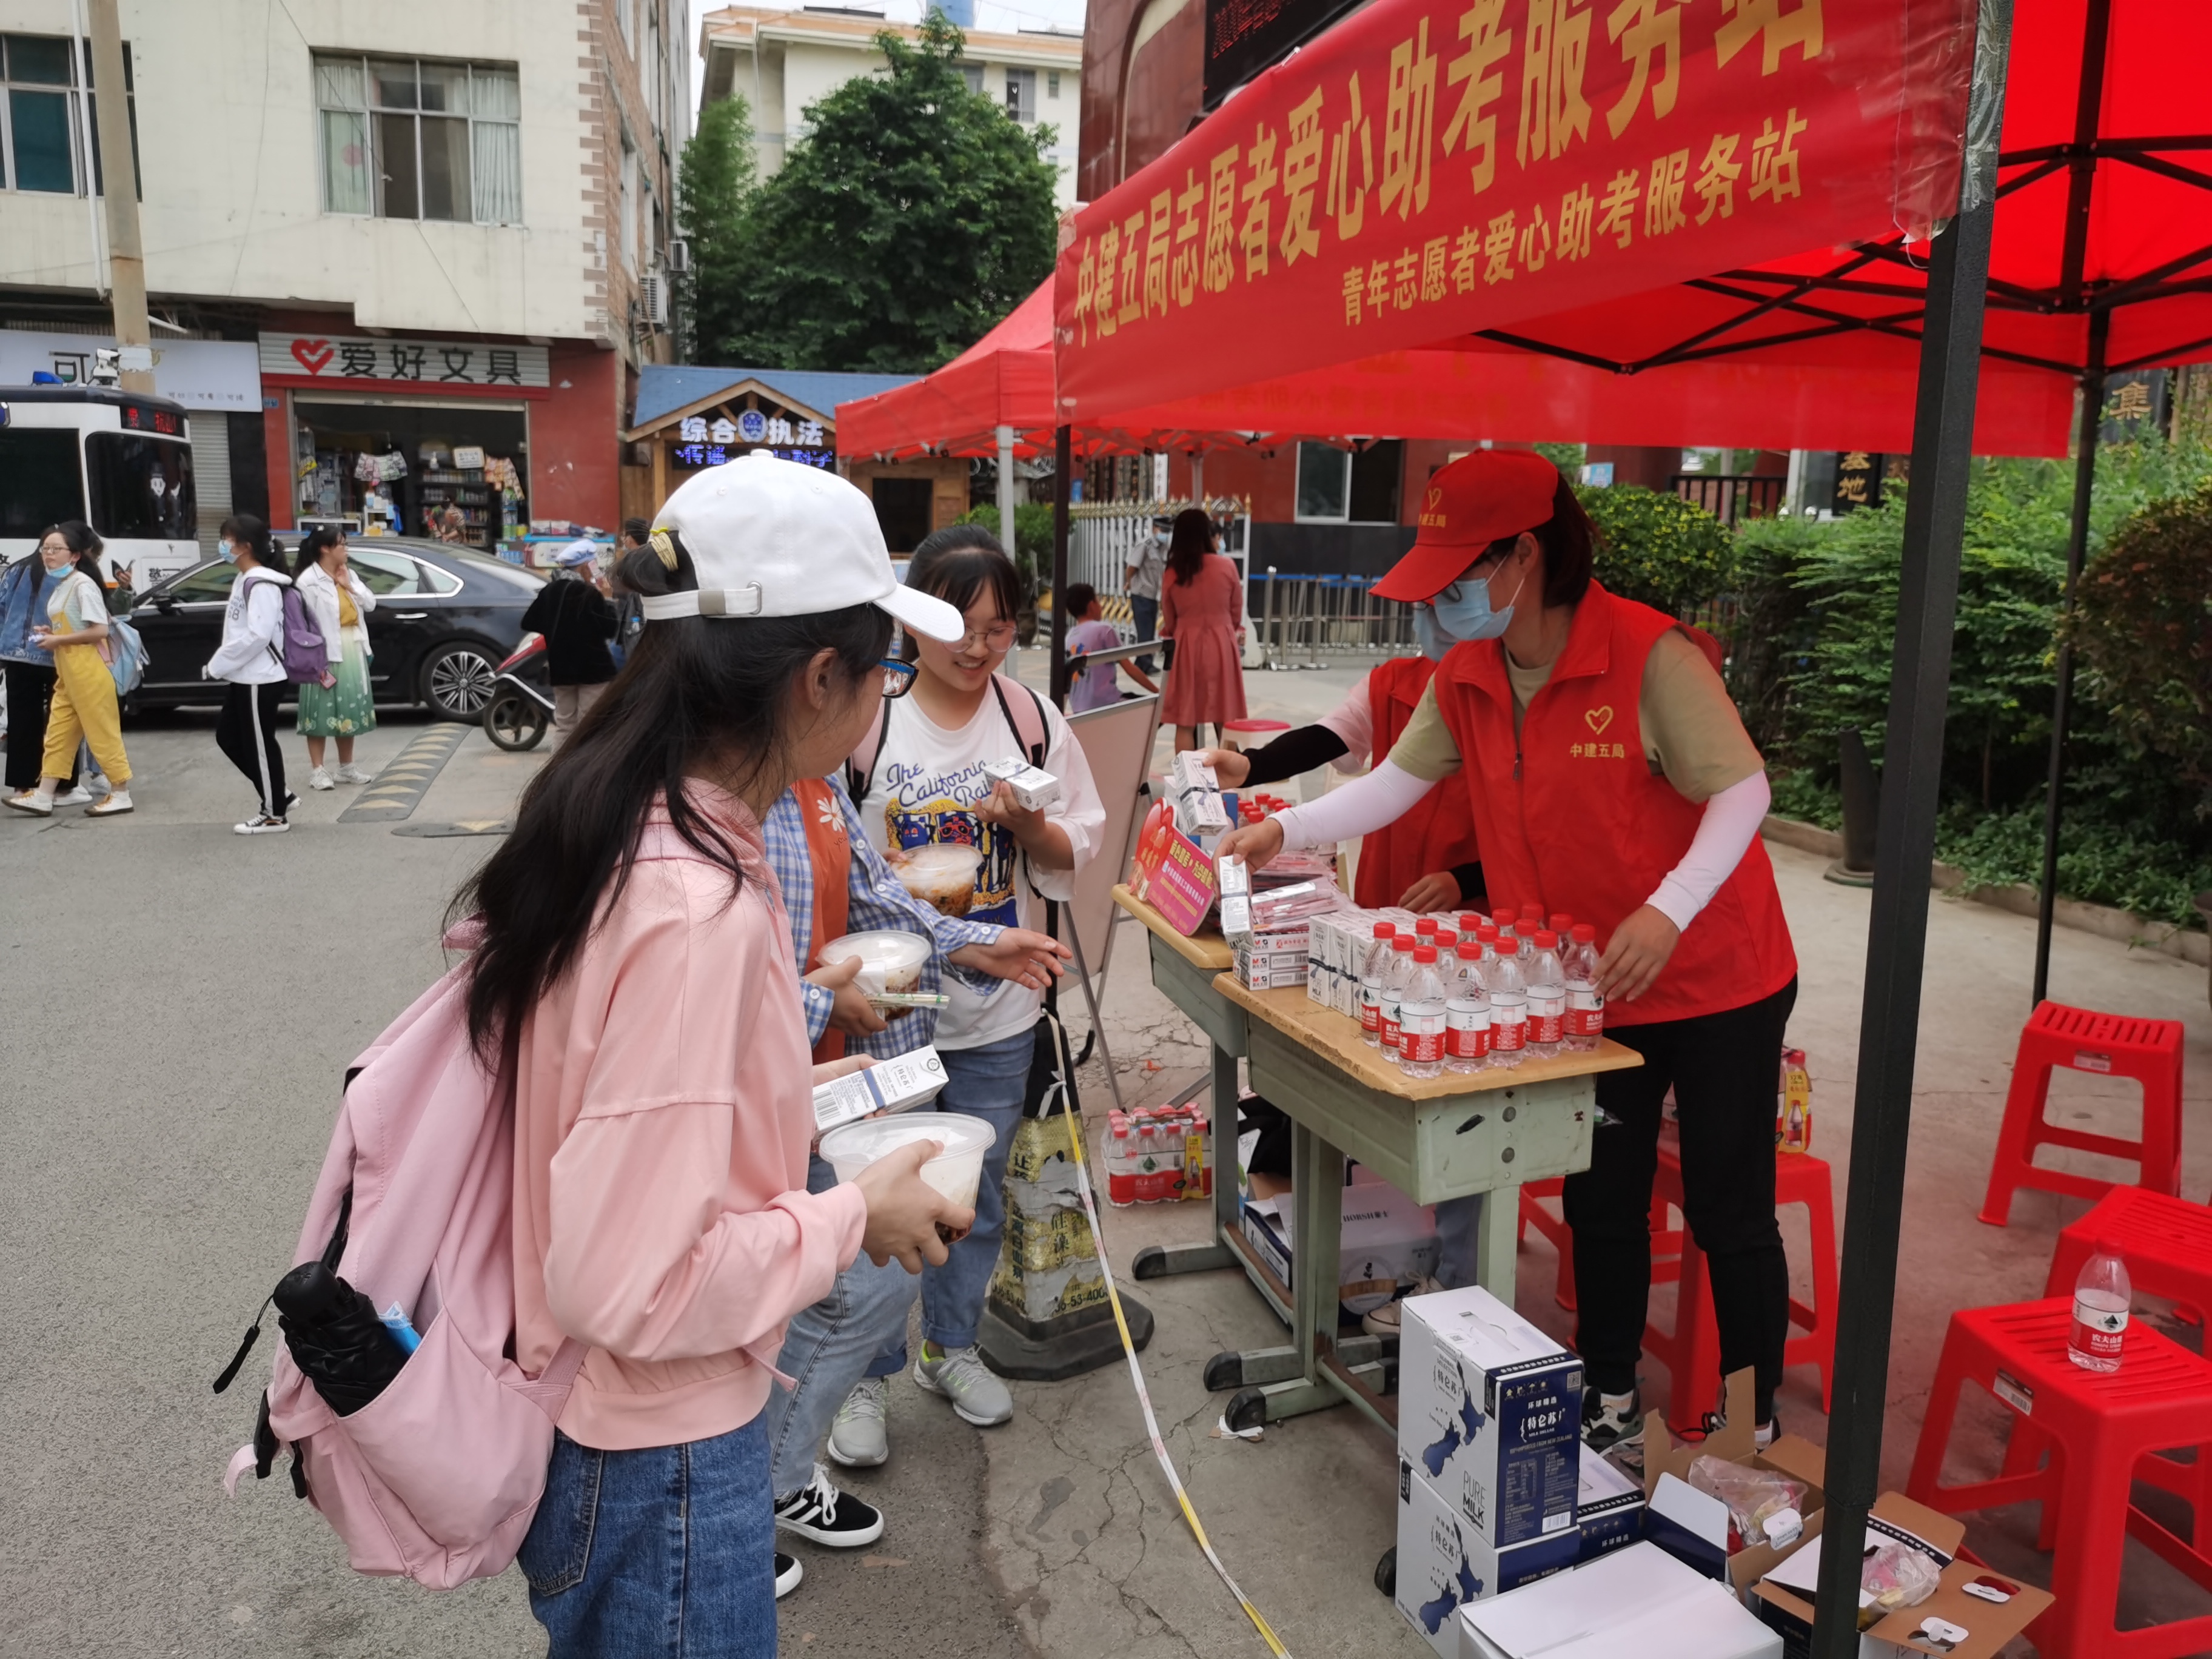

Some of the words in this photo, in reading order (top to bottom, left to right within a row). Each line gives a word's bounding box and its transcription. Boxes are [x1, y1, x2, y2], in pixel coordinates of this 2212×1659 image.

[1342, 107, 1809, 326] 青年志愿者爱心助考服务站
[340, 342, 521, 385] 爱好文具
[1569, 743, 1625, 759] 中建五局
[886, 763, 925, 791] The
[954, 780, 992, 807] Rai
[1527, 1412, 1557, 1430] 特仑苏
[1463, 1470, 1486, 1509] PURE
[1463, 1492, 1485, 1524] MILK
